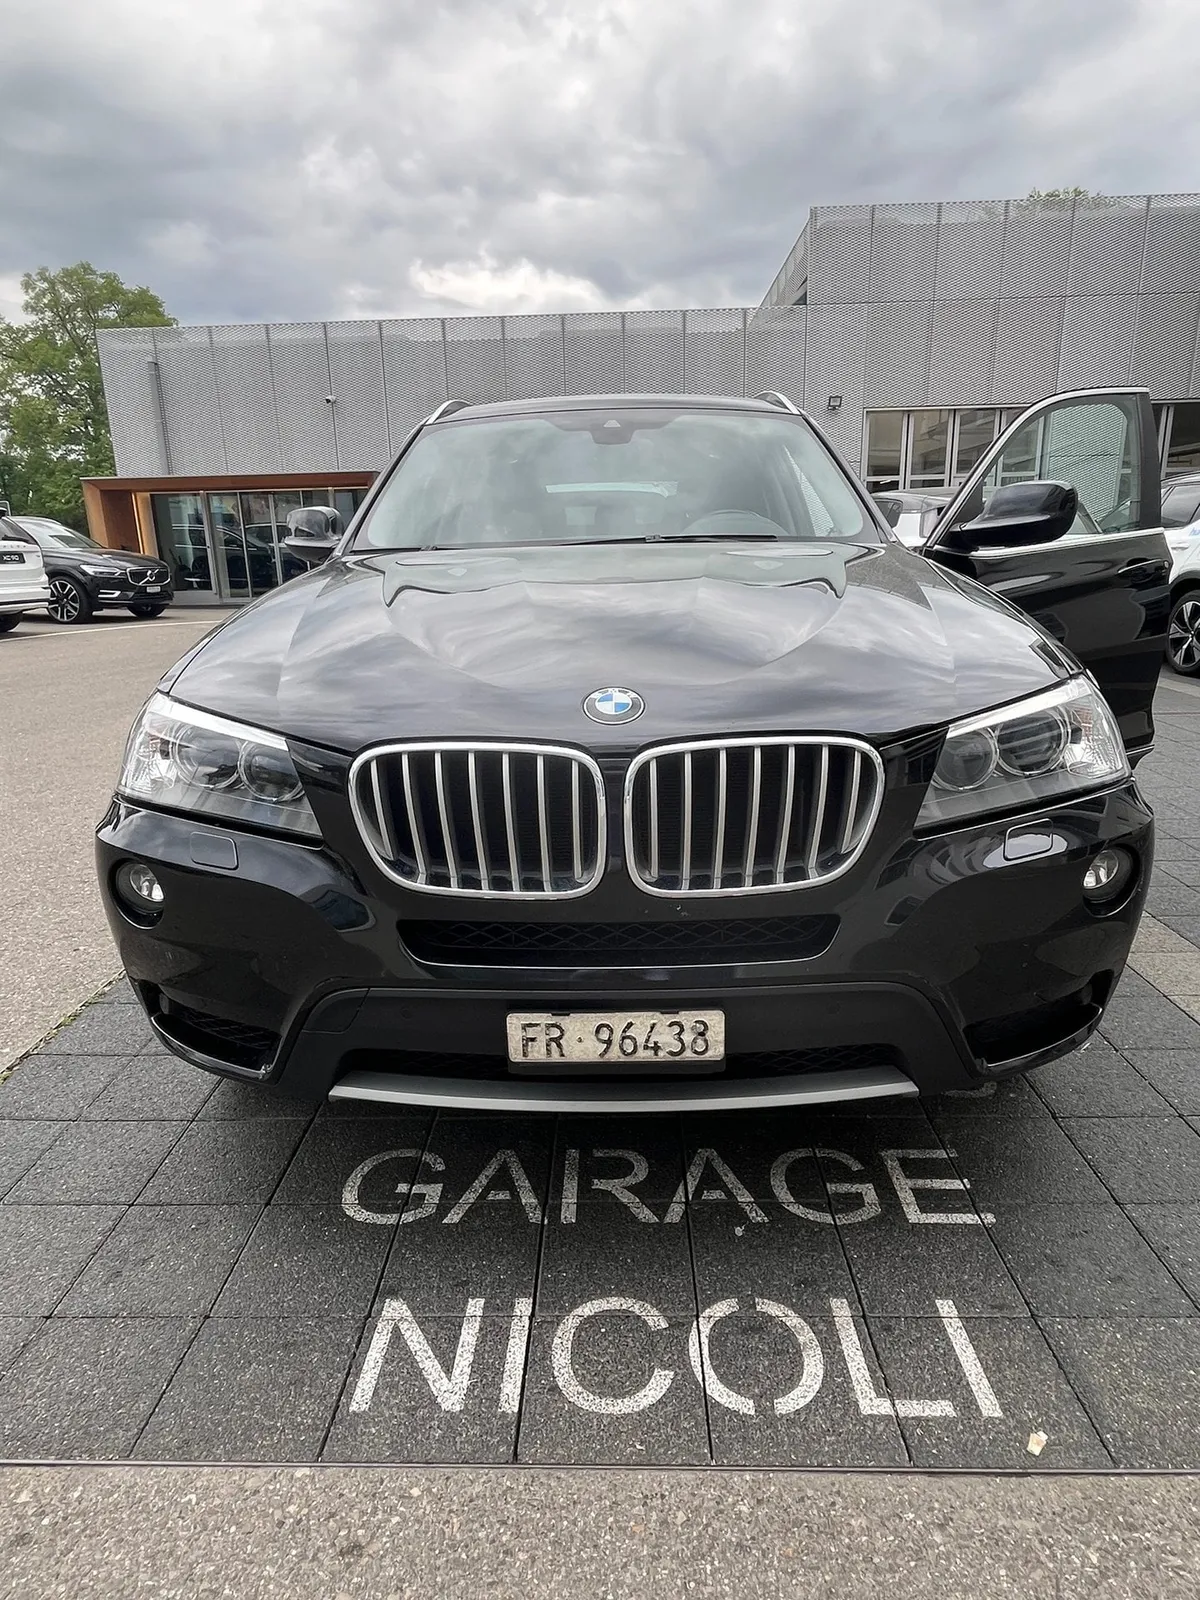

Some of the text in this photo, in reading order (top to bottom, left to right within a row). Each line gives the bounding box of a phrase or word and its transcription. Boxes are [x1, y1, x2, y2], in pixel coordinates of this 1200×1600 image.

[520, 1019, 710, 1058] FR 96438
[340, 1148, 996, 1225] GARAGE
[348, 1296, 1003, 1417] NICOLI
